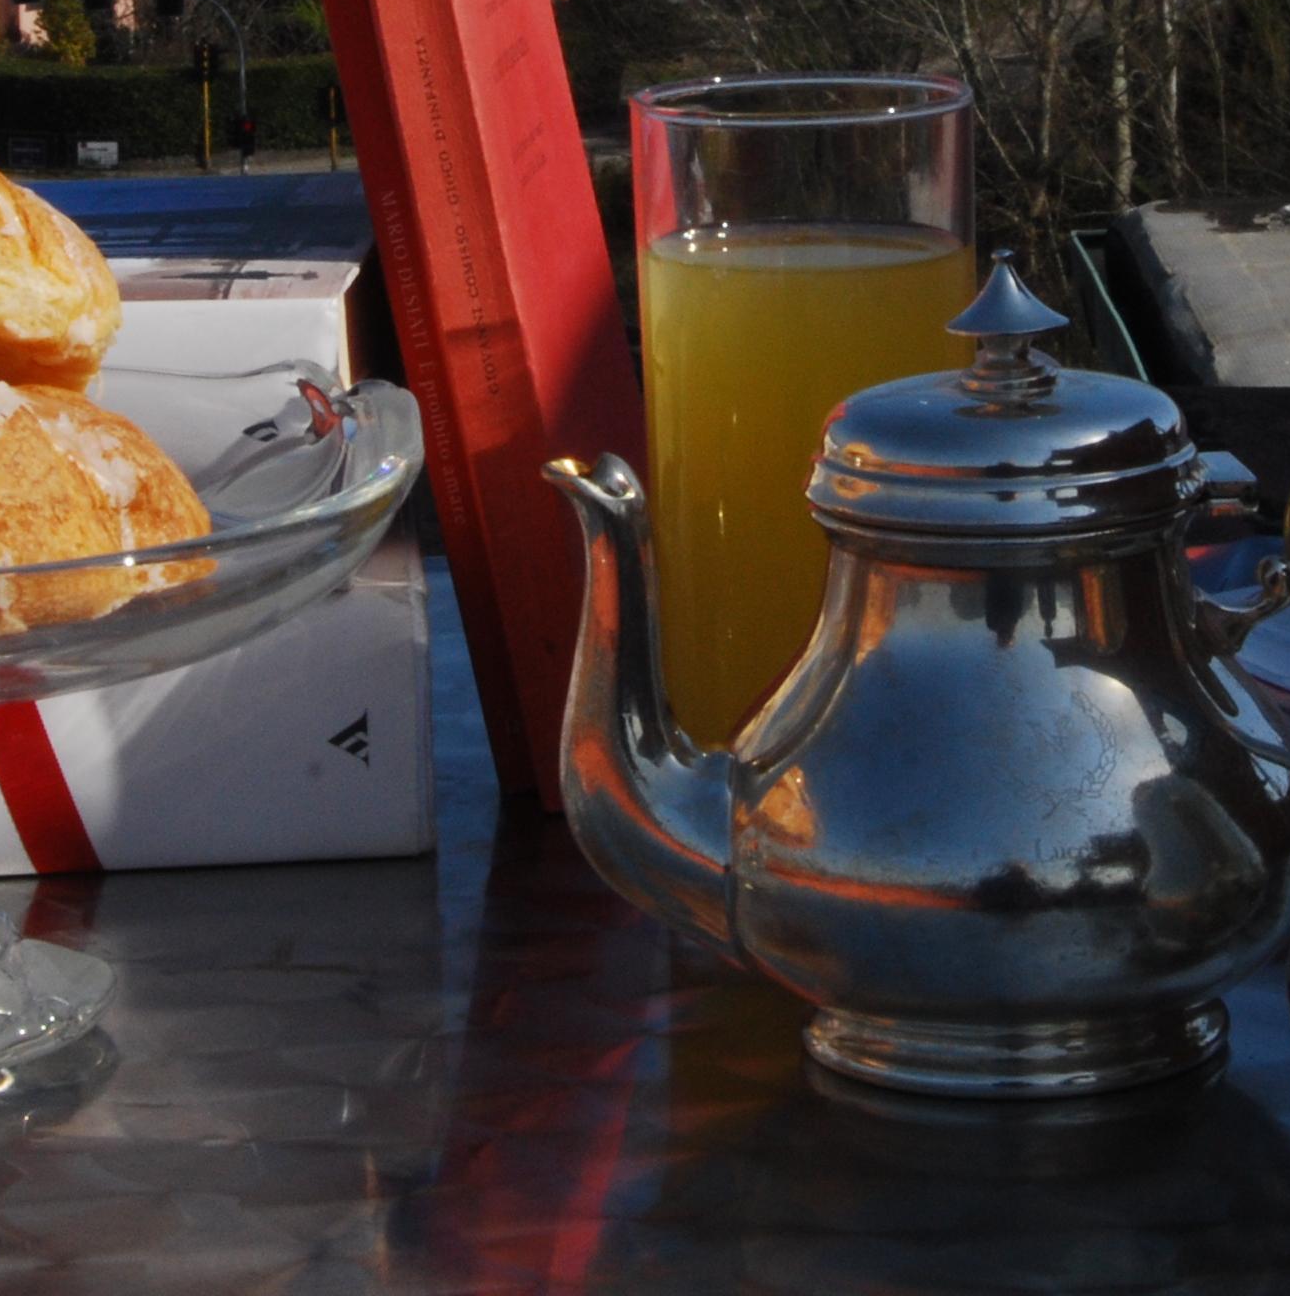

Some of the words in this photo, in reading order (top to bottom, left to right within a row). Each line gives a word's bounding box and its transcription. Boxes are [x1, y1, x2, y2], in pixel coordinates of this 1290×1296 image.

[439, 151, 459, 205] GIOCO
[455, 225, 479, 298] COMISSO
[380, 190, 407, 260] MARIO
[418, 380, 451, 460] proibito
[472, 308, 499, 394] GIOVANNI
